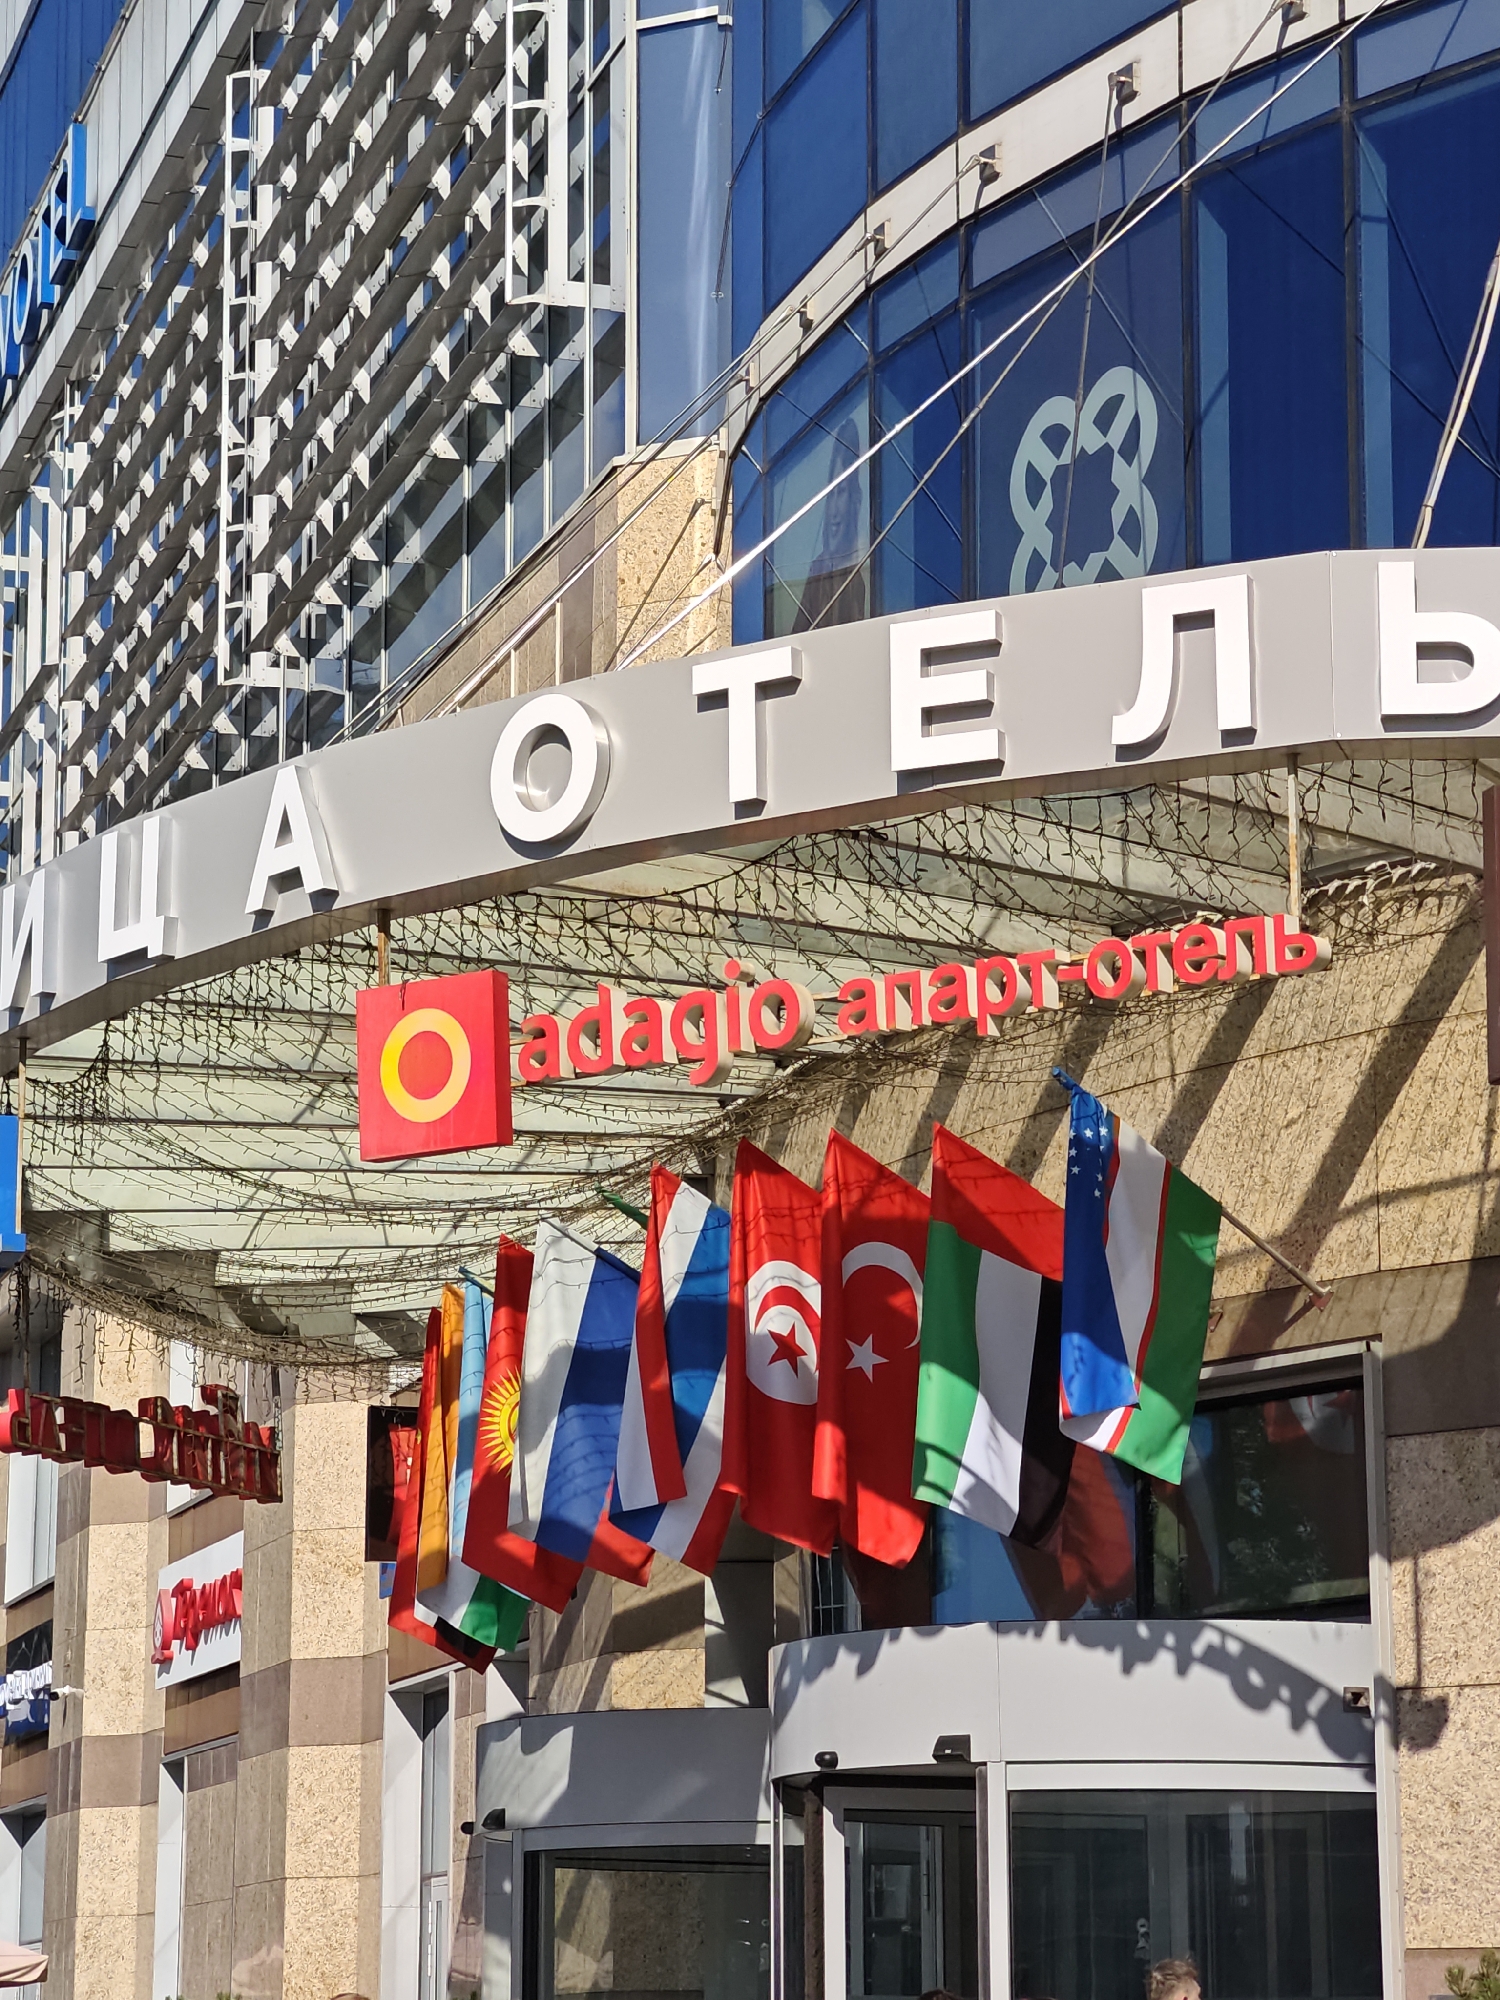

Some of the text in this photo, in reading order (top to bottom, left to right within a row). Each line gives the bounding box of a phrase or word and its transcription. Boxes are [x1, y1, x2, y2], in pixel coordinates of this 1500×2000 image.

[490, 561, 1500, 842] ОТЕЛЬ
[518, 914, 1328, 1087] adagio апарт-отель
